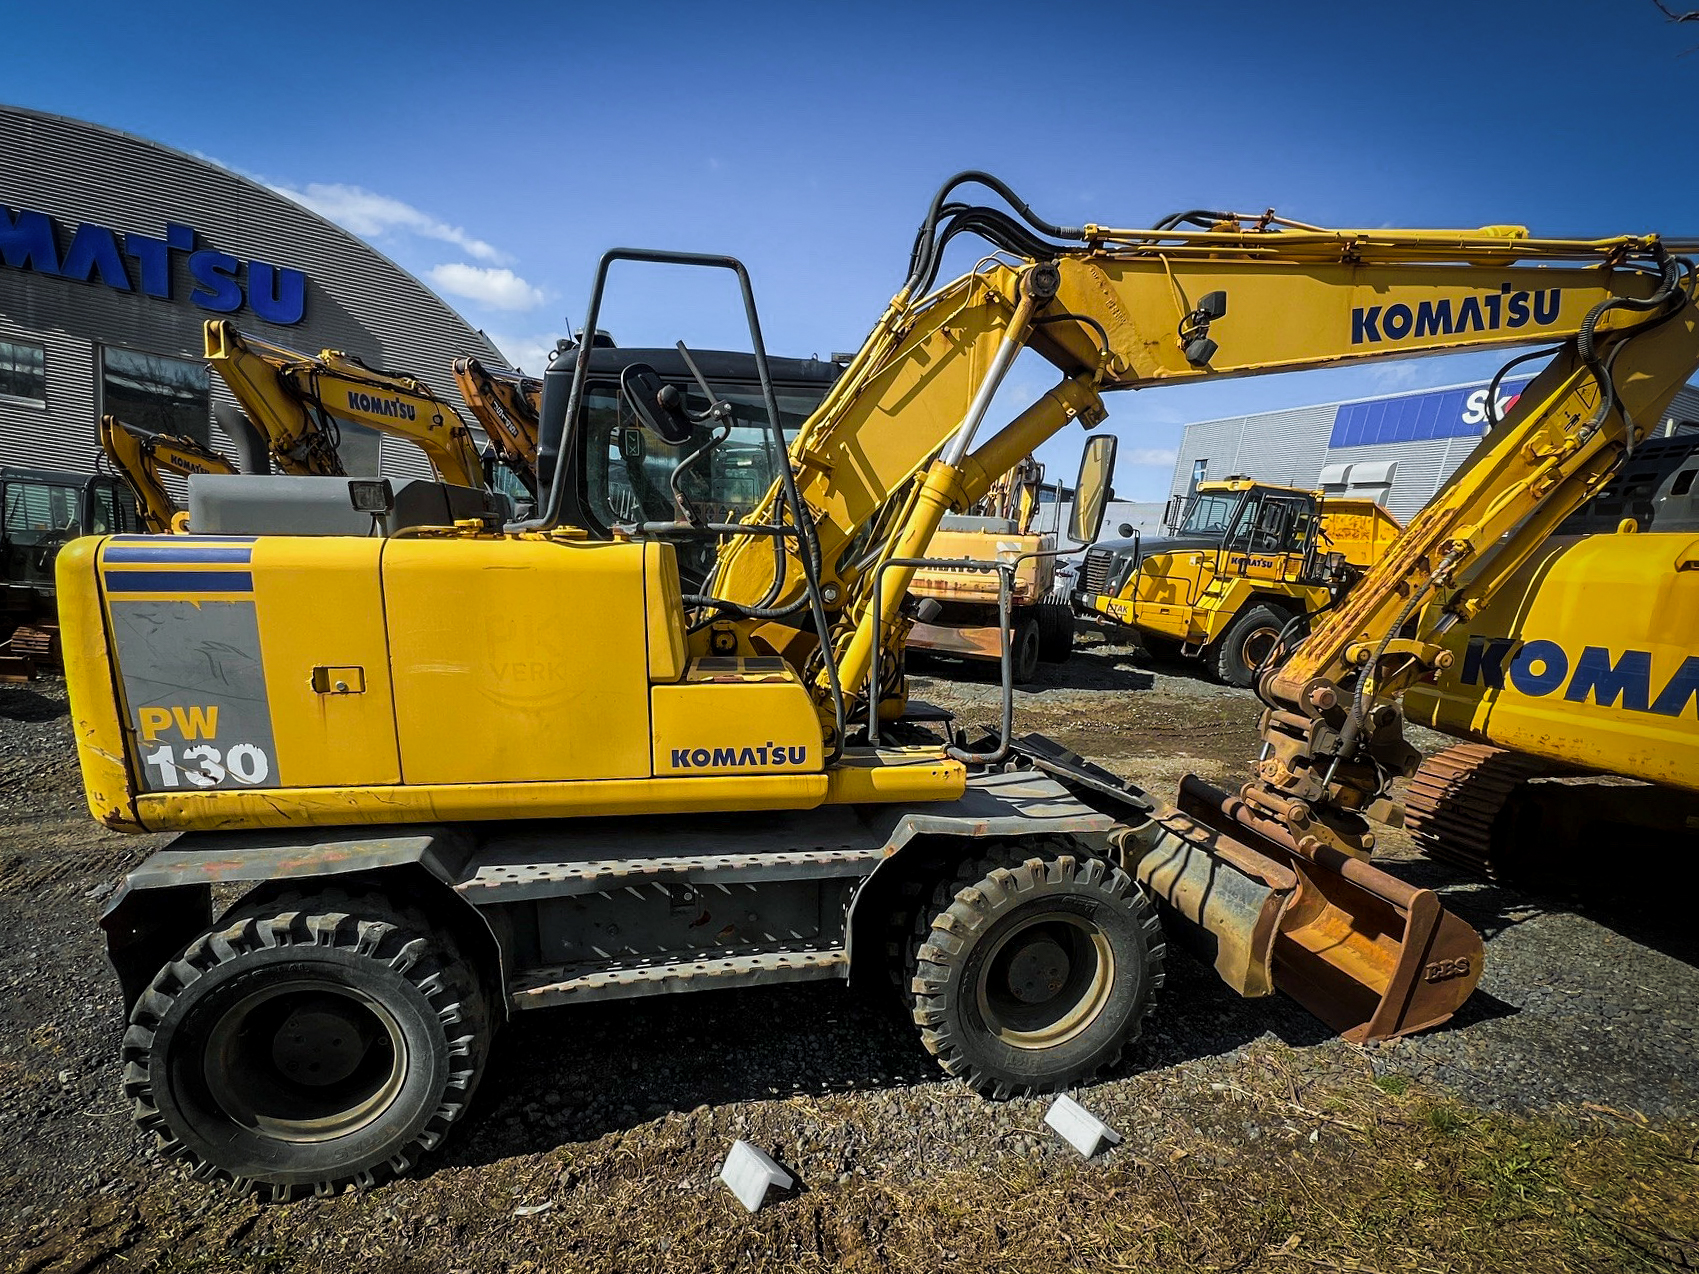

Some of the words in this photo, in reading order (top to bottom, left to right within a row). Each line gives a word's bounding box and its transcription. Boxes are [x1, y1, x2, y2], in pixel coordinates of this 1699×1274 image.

[1351, 282, 1562, 345] KOMATSU
[347, 391, 416, 421] KOMATSU
[138, 706, 219, 741] PW
[147, 743, 269, 788] 130
[671, 741, 806, 768] KOMATSU
